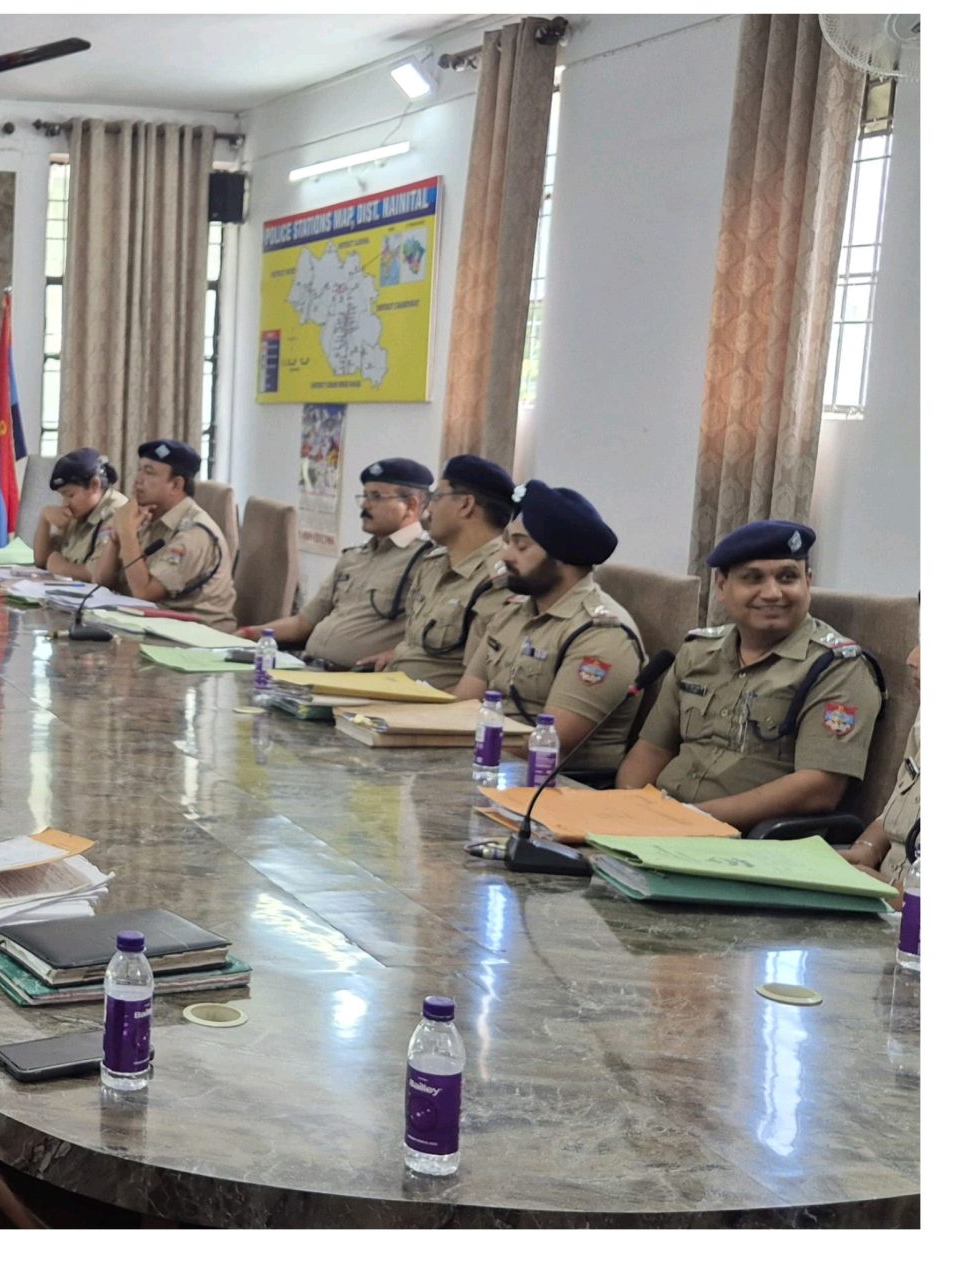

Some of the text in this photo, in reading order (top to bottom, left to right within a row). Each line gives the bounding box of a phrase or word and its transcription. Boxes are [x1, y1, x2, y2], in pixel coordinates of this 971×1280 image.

[265, 225, 292, 244] POLICE
[292, 213, 331, 241] STATIONS
[382, 189, 428, 216] NAINITAL
